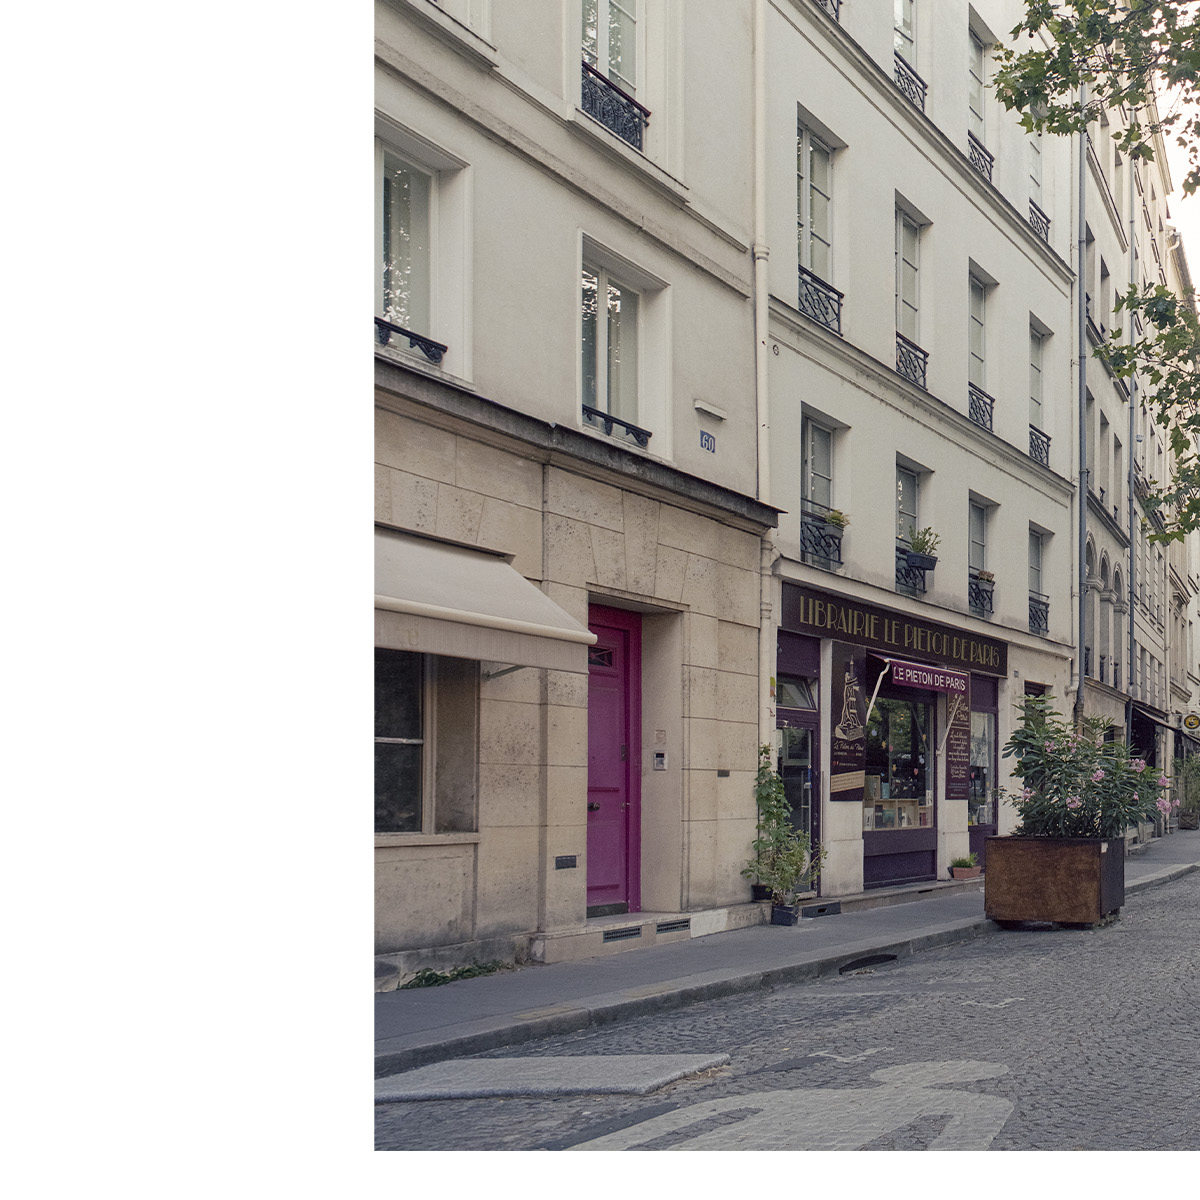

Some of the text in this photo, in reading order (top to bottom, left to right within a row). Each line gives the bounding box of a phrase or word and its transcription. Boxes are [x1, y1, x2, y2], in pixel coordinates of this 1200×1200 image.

[702, 434, 715, 452] 60
[800, 595, 1000, 668] LIBRAIRIE LE PIETON DE PARIS
[893, 666, 966, 691] LE PIETON DE PARIS
